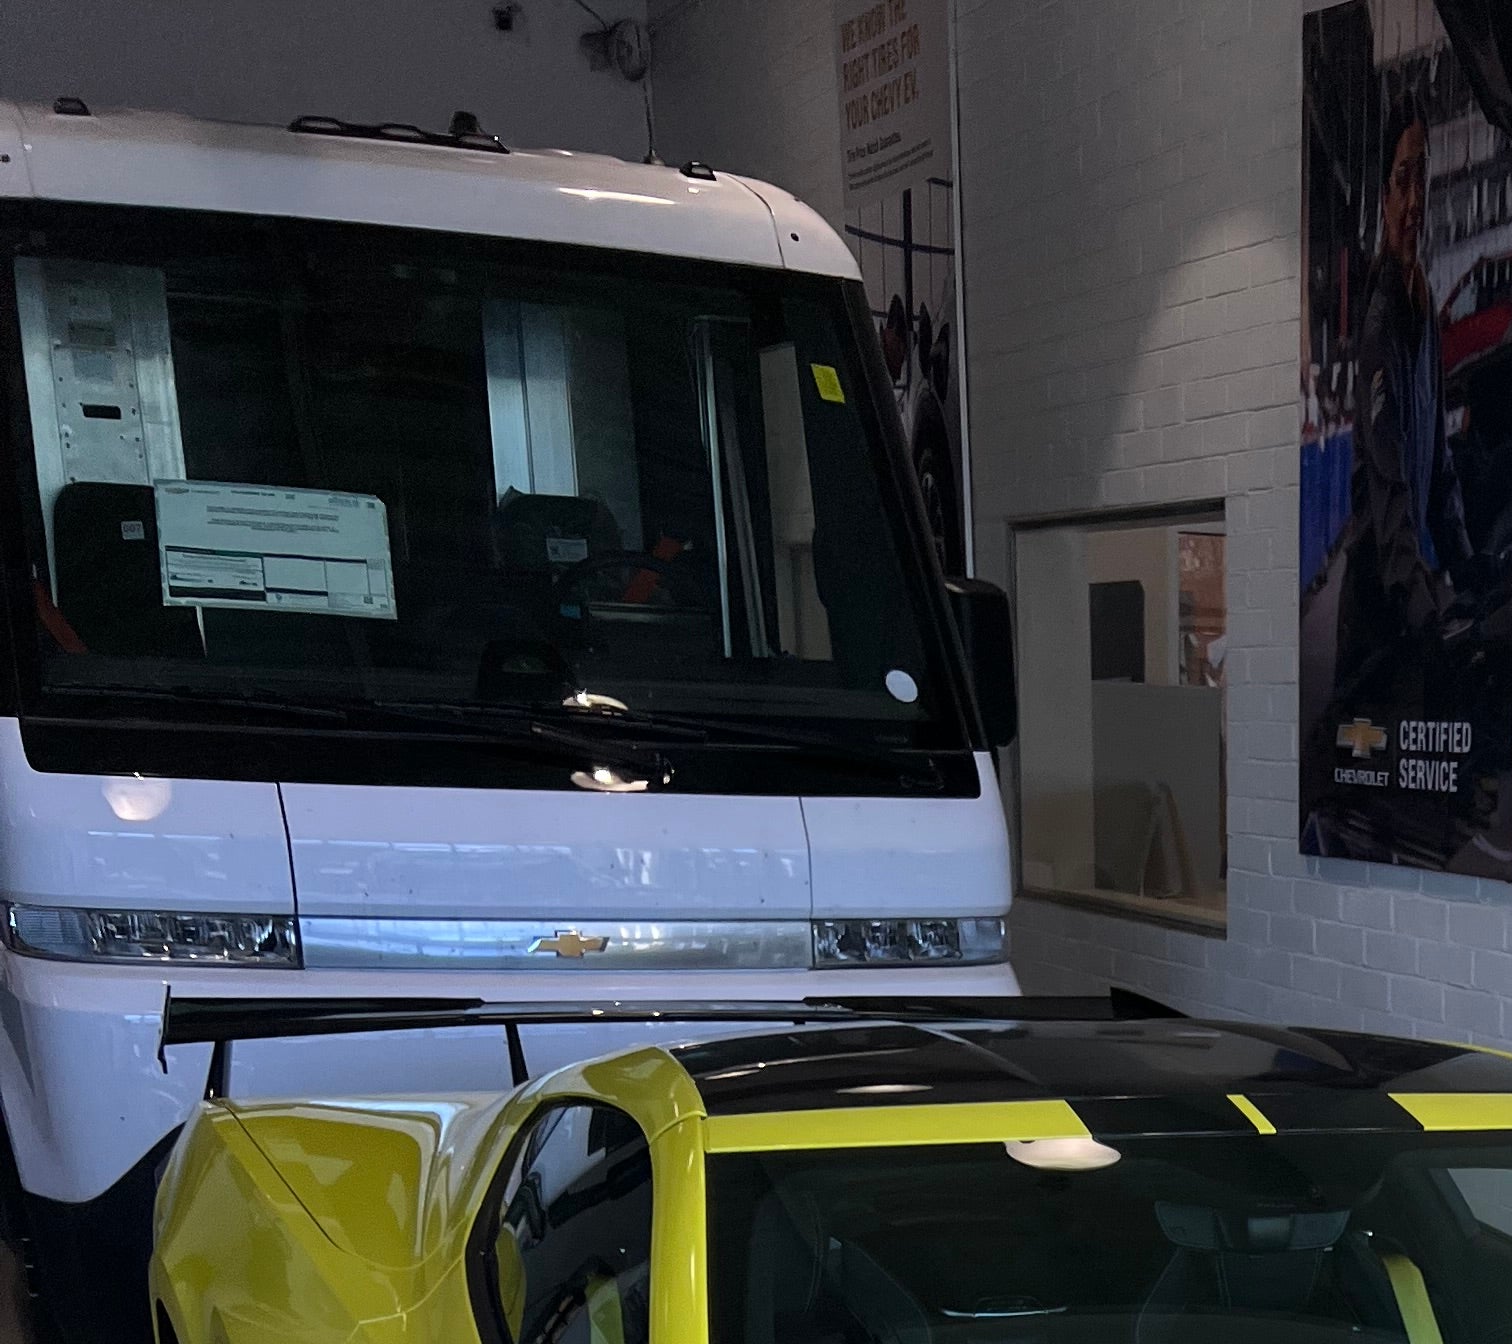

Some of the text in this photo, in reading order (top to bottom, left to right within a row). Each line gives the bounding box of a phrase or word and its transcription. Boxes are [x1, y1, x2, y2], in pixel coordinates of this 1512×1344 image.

[841, 20, 857, 53] WE
[857, 3, 886, 45] KNOW
[843, 23, 920, 93] RIGHT TIRES FOR
[845, 94, 870, 130] YOUR
[871, 75, 900, 121] CHEVY
[1400, 720, 1472, 753] CERTIFIED
[1334, 767, 1390, 786] CHEVROLET
[1398, 758, 1458, 793] SERVICE
